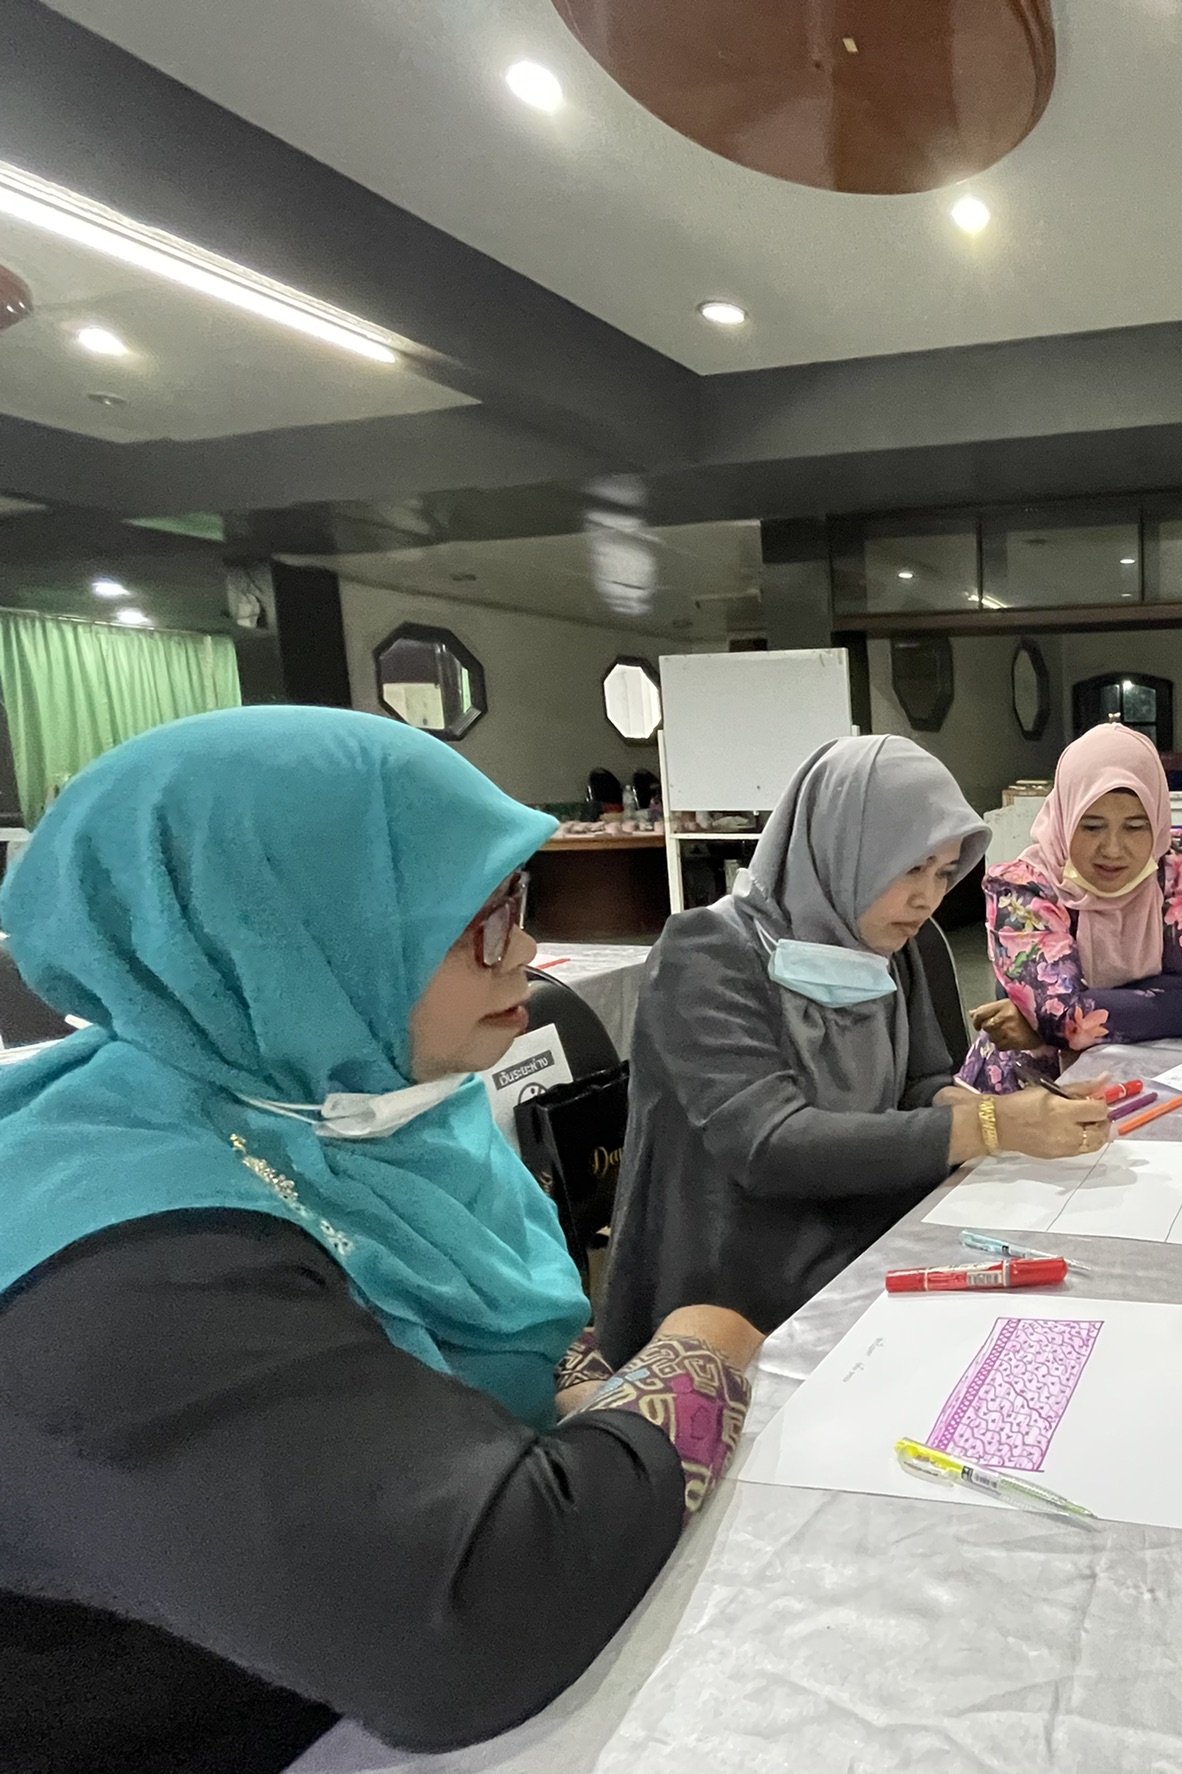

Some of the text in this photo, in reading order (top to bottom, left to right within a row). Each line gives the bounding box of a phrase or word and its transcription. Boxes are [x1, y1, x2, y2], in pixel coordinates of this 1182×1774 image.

[498, 1056, 549, 1086] เว้นระยะห่าง
